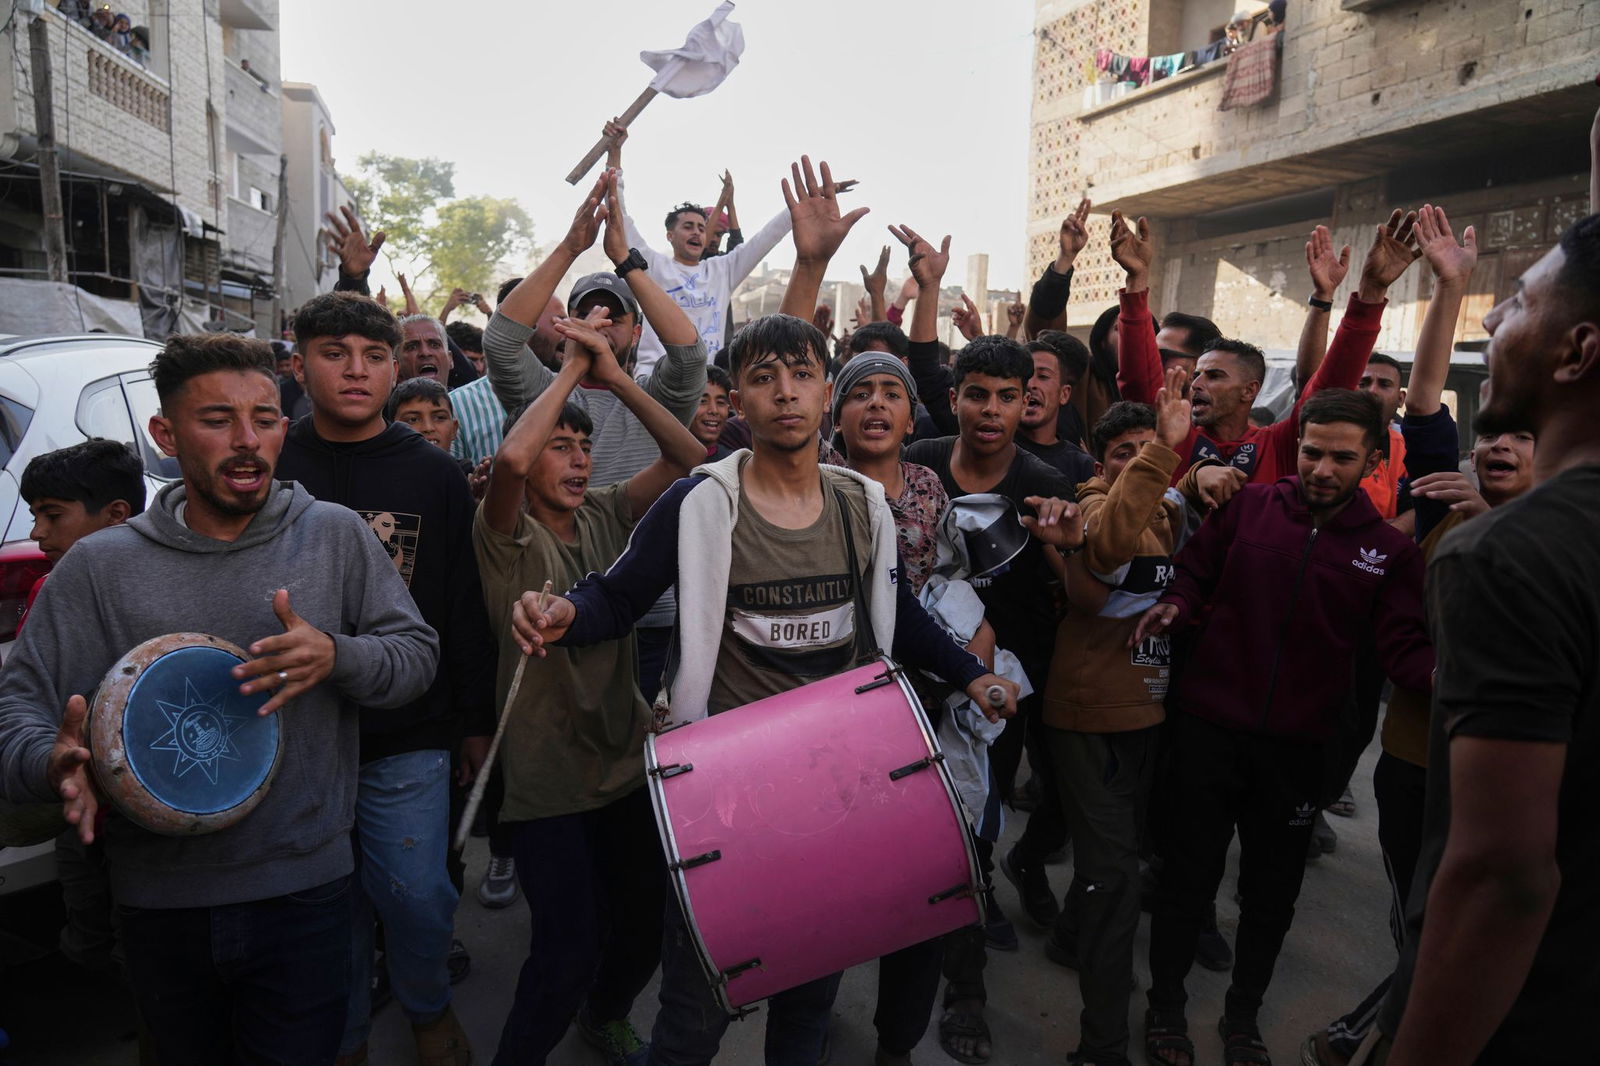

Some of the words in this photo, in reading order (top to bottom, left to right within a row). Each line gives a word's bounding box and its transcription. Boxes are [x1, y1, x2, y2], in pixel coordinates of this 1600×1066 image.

[1154, 564, 1176, 587] RA
[1351, 559, 1385, 576] adidas
[743, 579, 850, 605] CONSTANTLY
[770, 620, 829, 642] BORED
